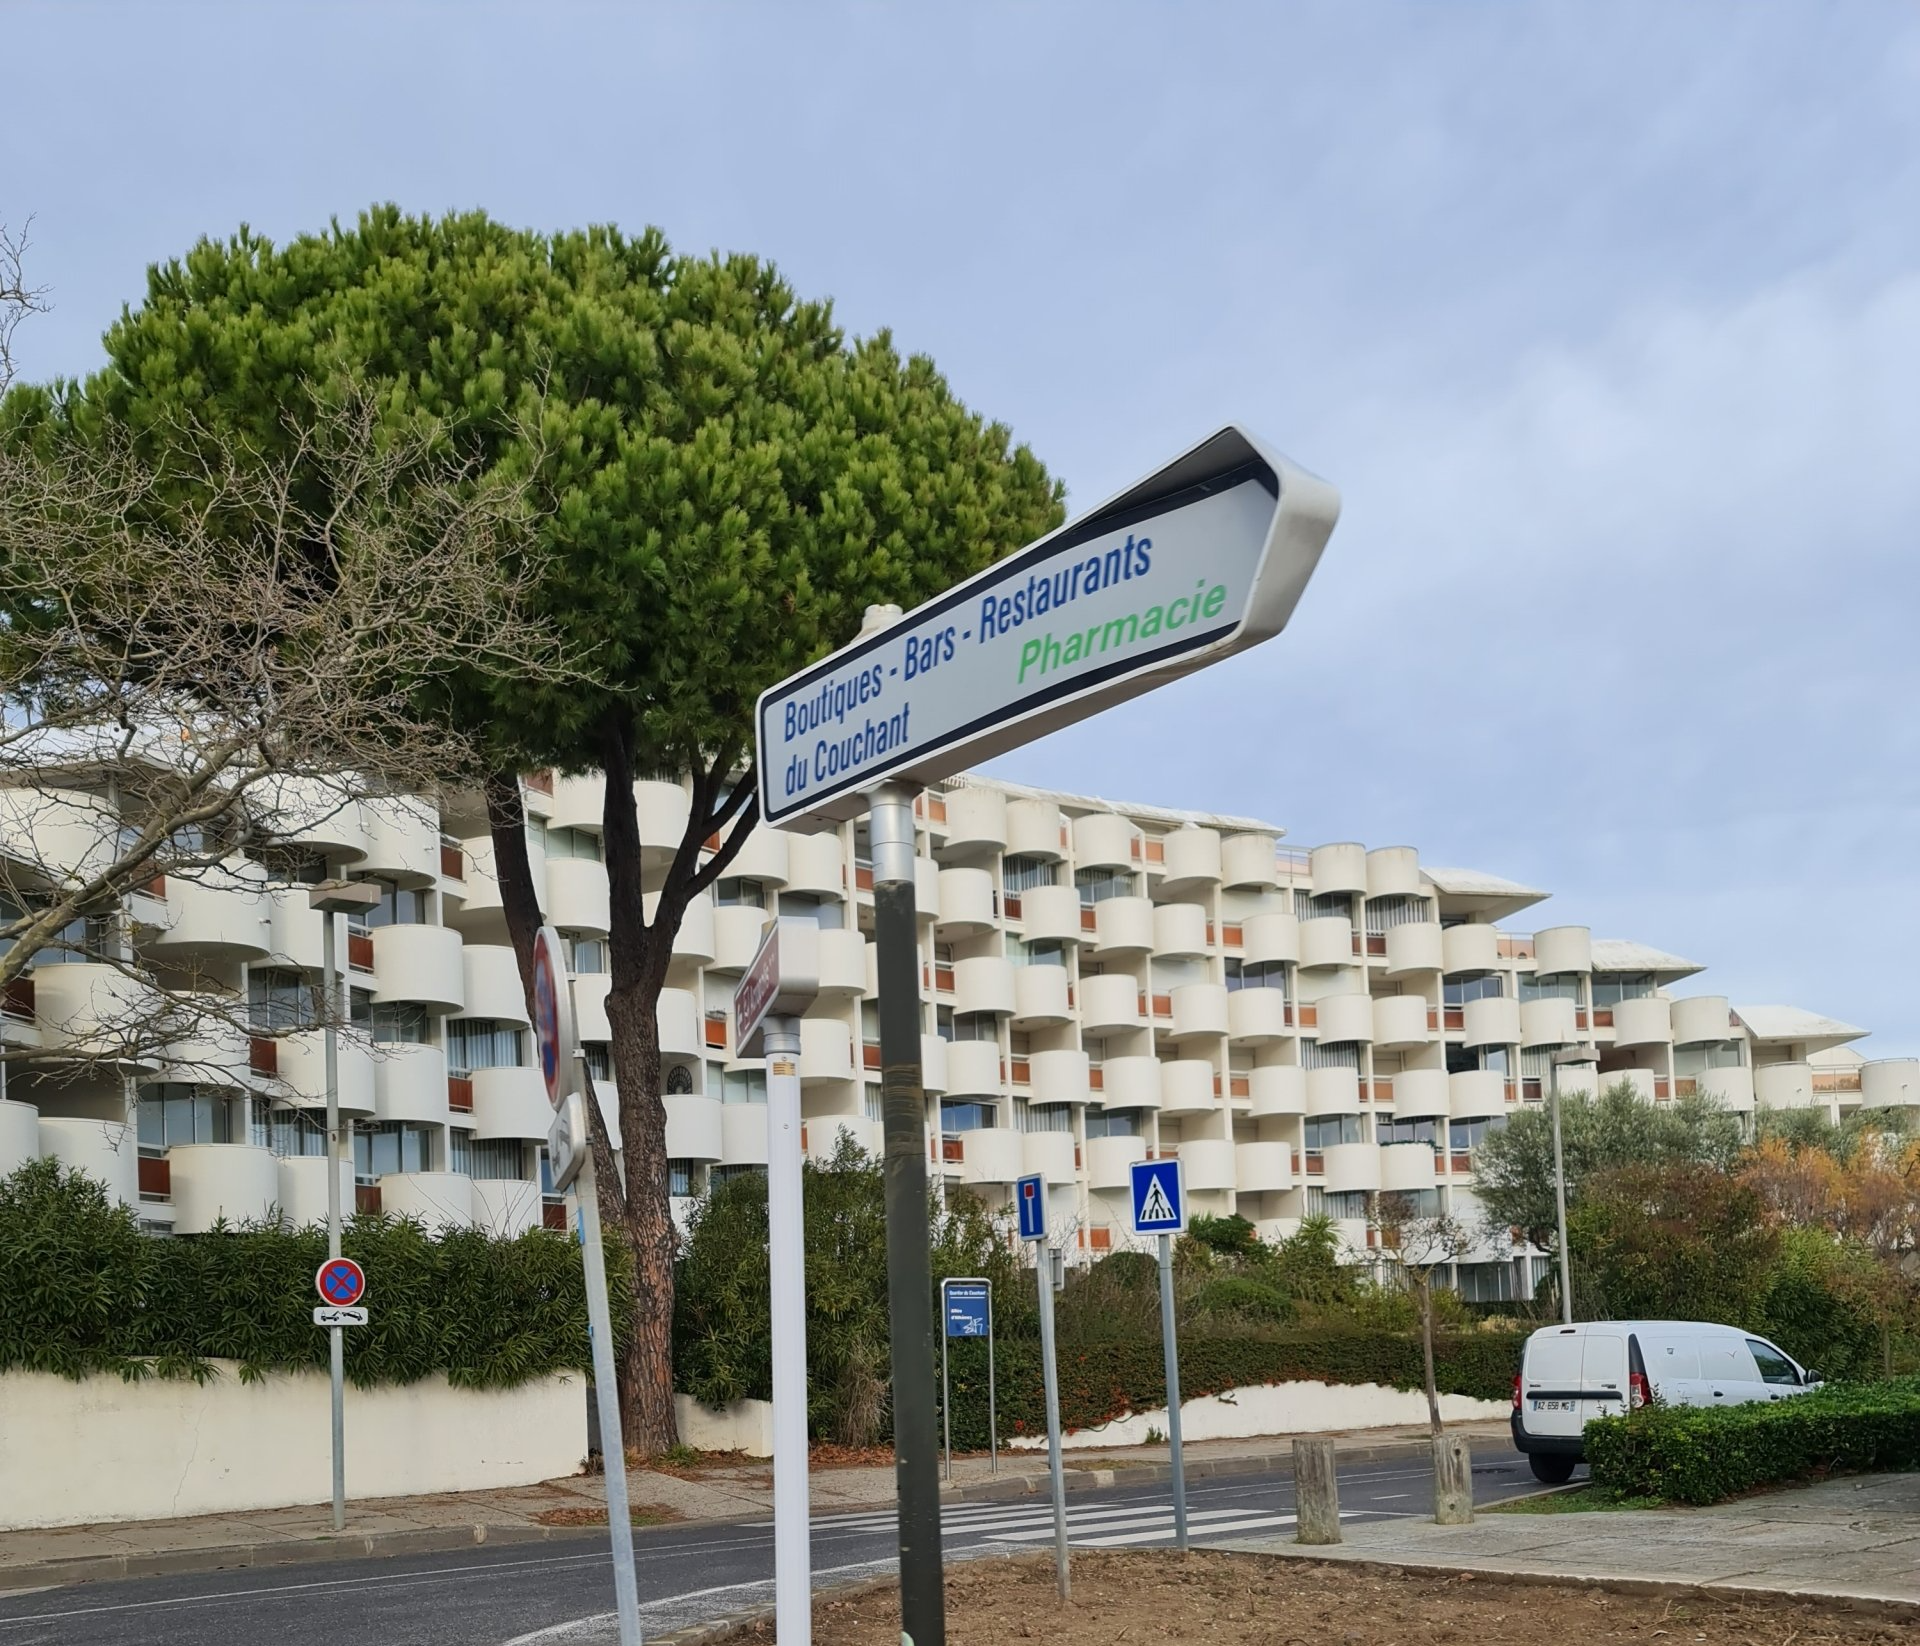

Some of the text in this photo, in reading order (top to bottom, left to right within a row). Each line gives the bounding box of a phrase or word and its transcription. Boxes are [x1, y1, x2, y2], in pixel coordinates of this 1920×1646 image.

[784, 534, 1153, 743] Boutiques - Bars - Restaurants
[1017, 578, 1225, 684] Pharmacie
[784, 704, 910, 797] du Couchant
